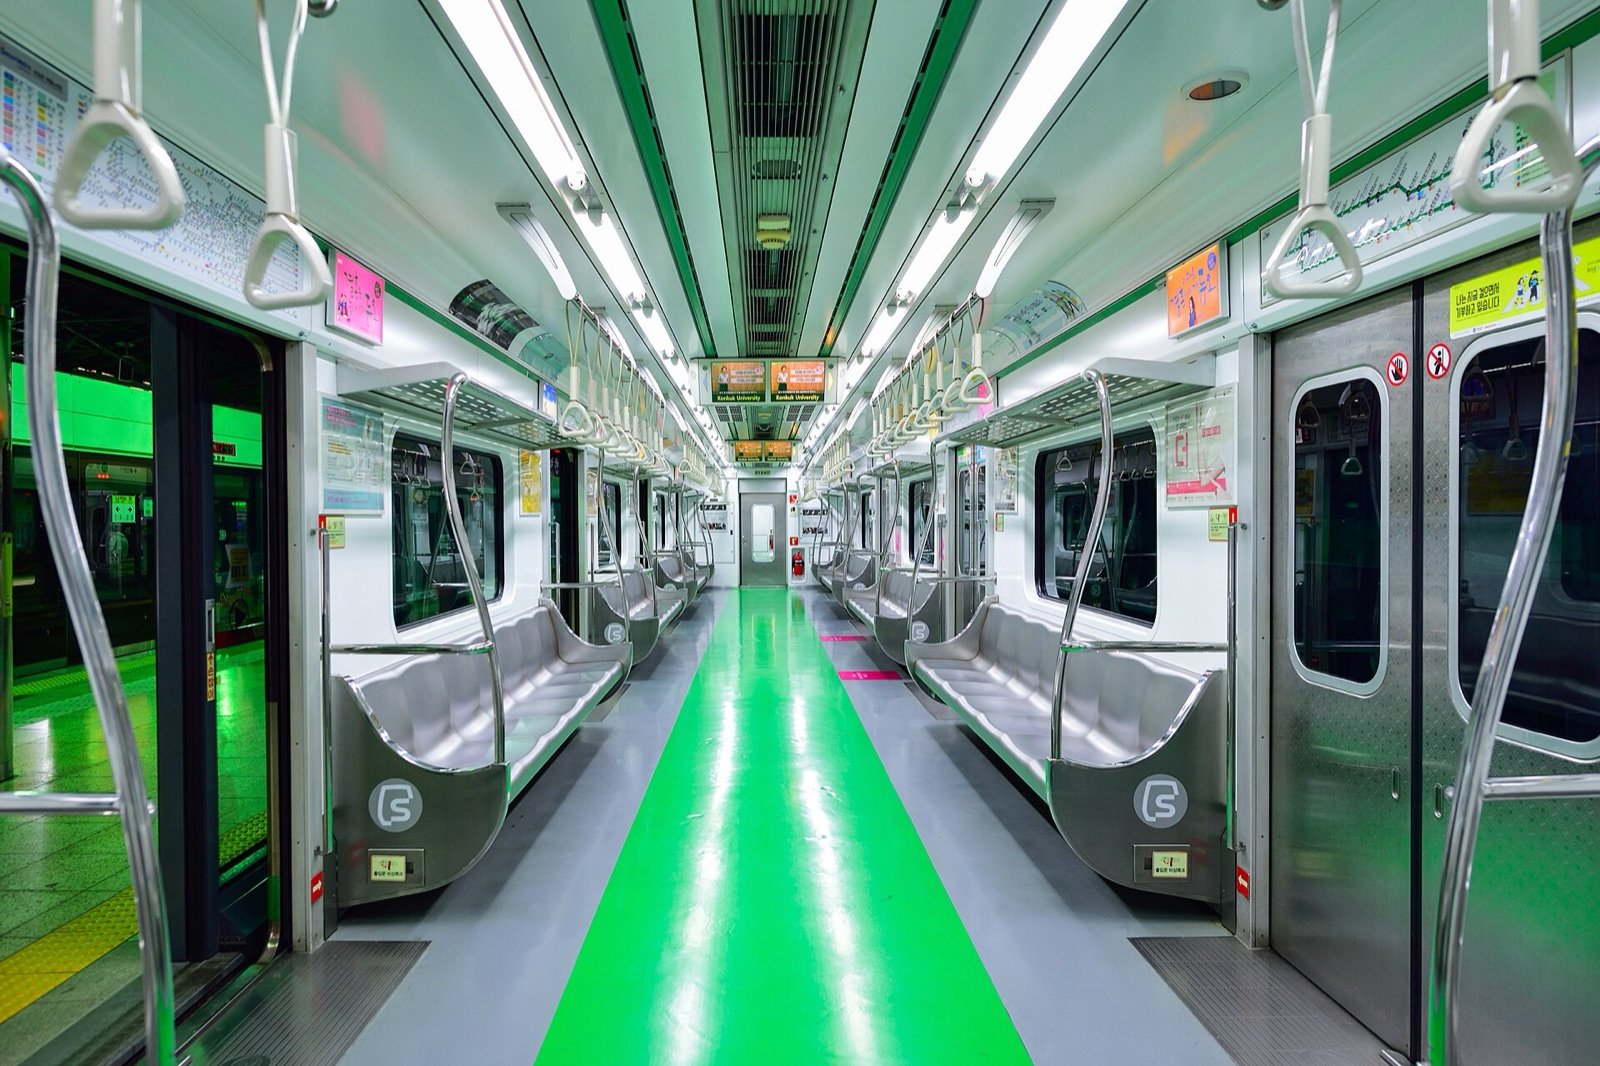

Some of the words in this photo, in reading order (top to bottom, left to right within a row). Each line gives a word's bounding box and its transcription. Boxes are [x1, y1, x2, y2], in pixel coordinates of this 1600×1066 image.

[1455, 294, 1466, 306] 나는
[1467, 289, 1478, 303] 지금
[1479, 281, 1500, 299] 걸으면서
[1455, 302, 1476, 319] 기부하고
[1476, 295, 1500, 313] 있습니다
